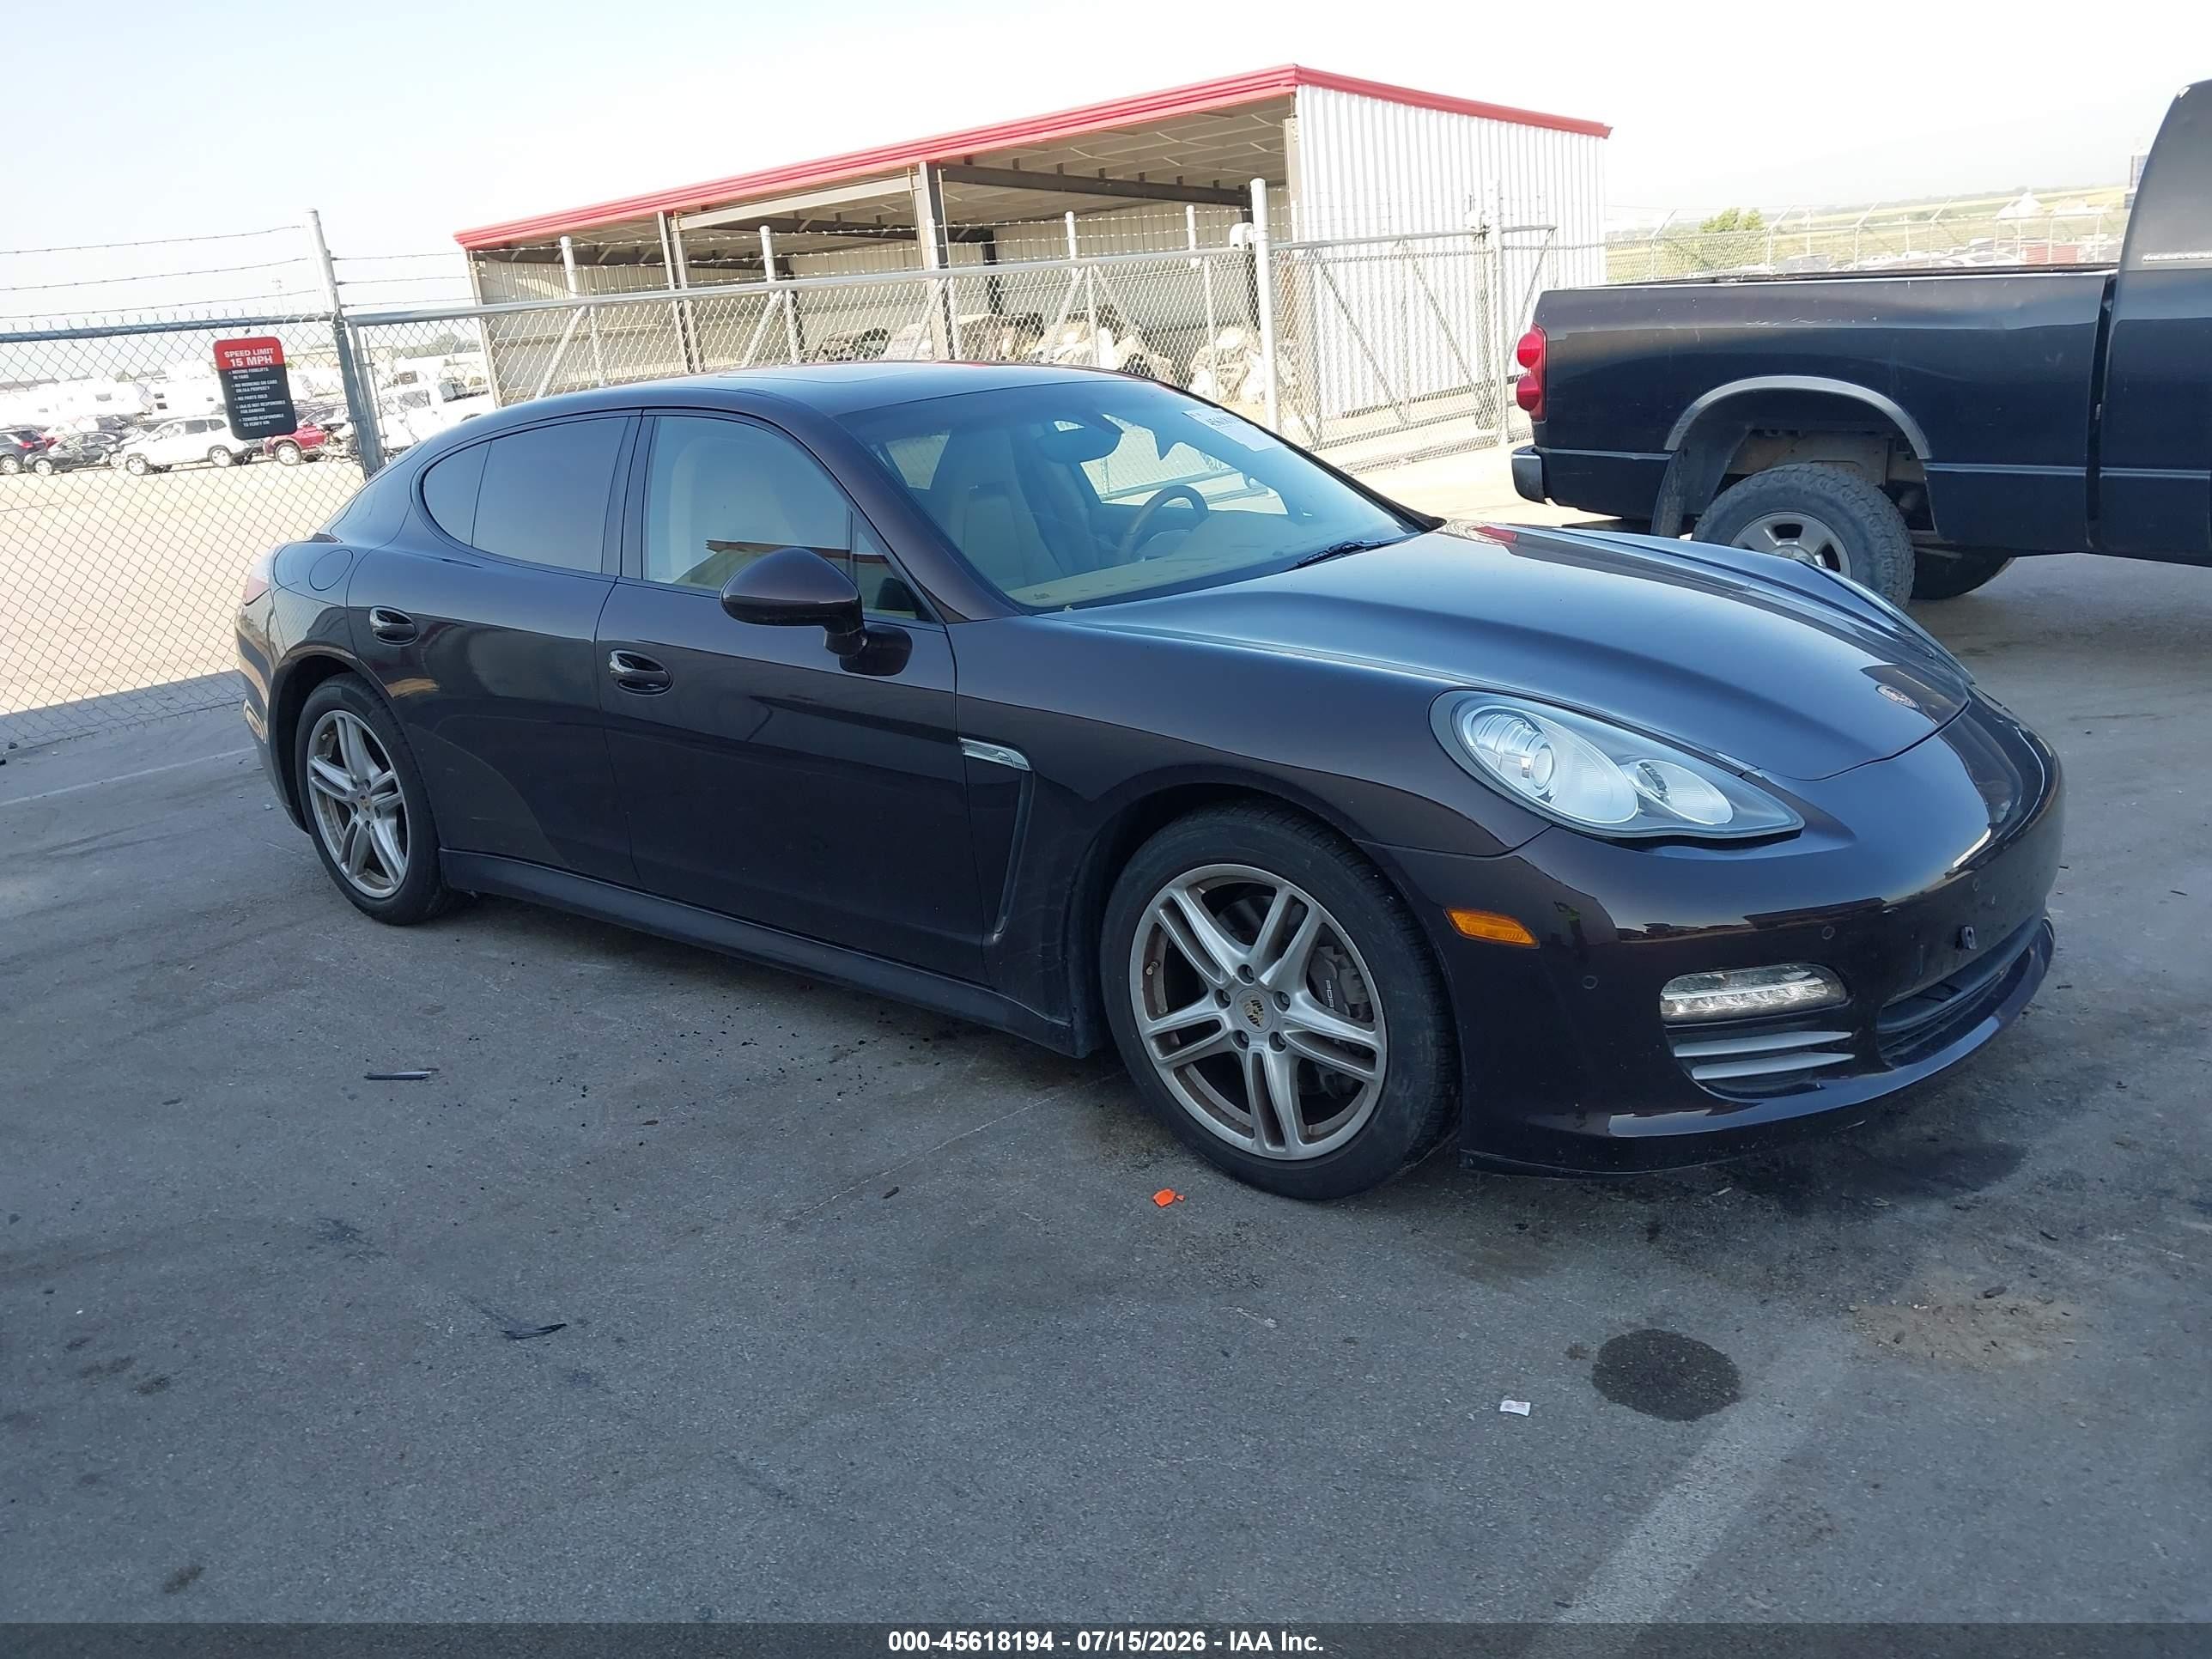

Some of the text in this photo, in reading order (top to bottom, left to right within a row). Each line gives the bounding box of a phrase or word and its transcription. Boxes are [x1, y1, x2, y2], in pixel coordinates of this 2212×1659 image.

[224, 347, 275, 358] SPEED LIMIT
[230, 356, 273, 367] 15 MPH
